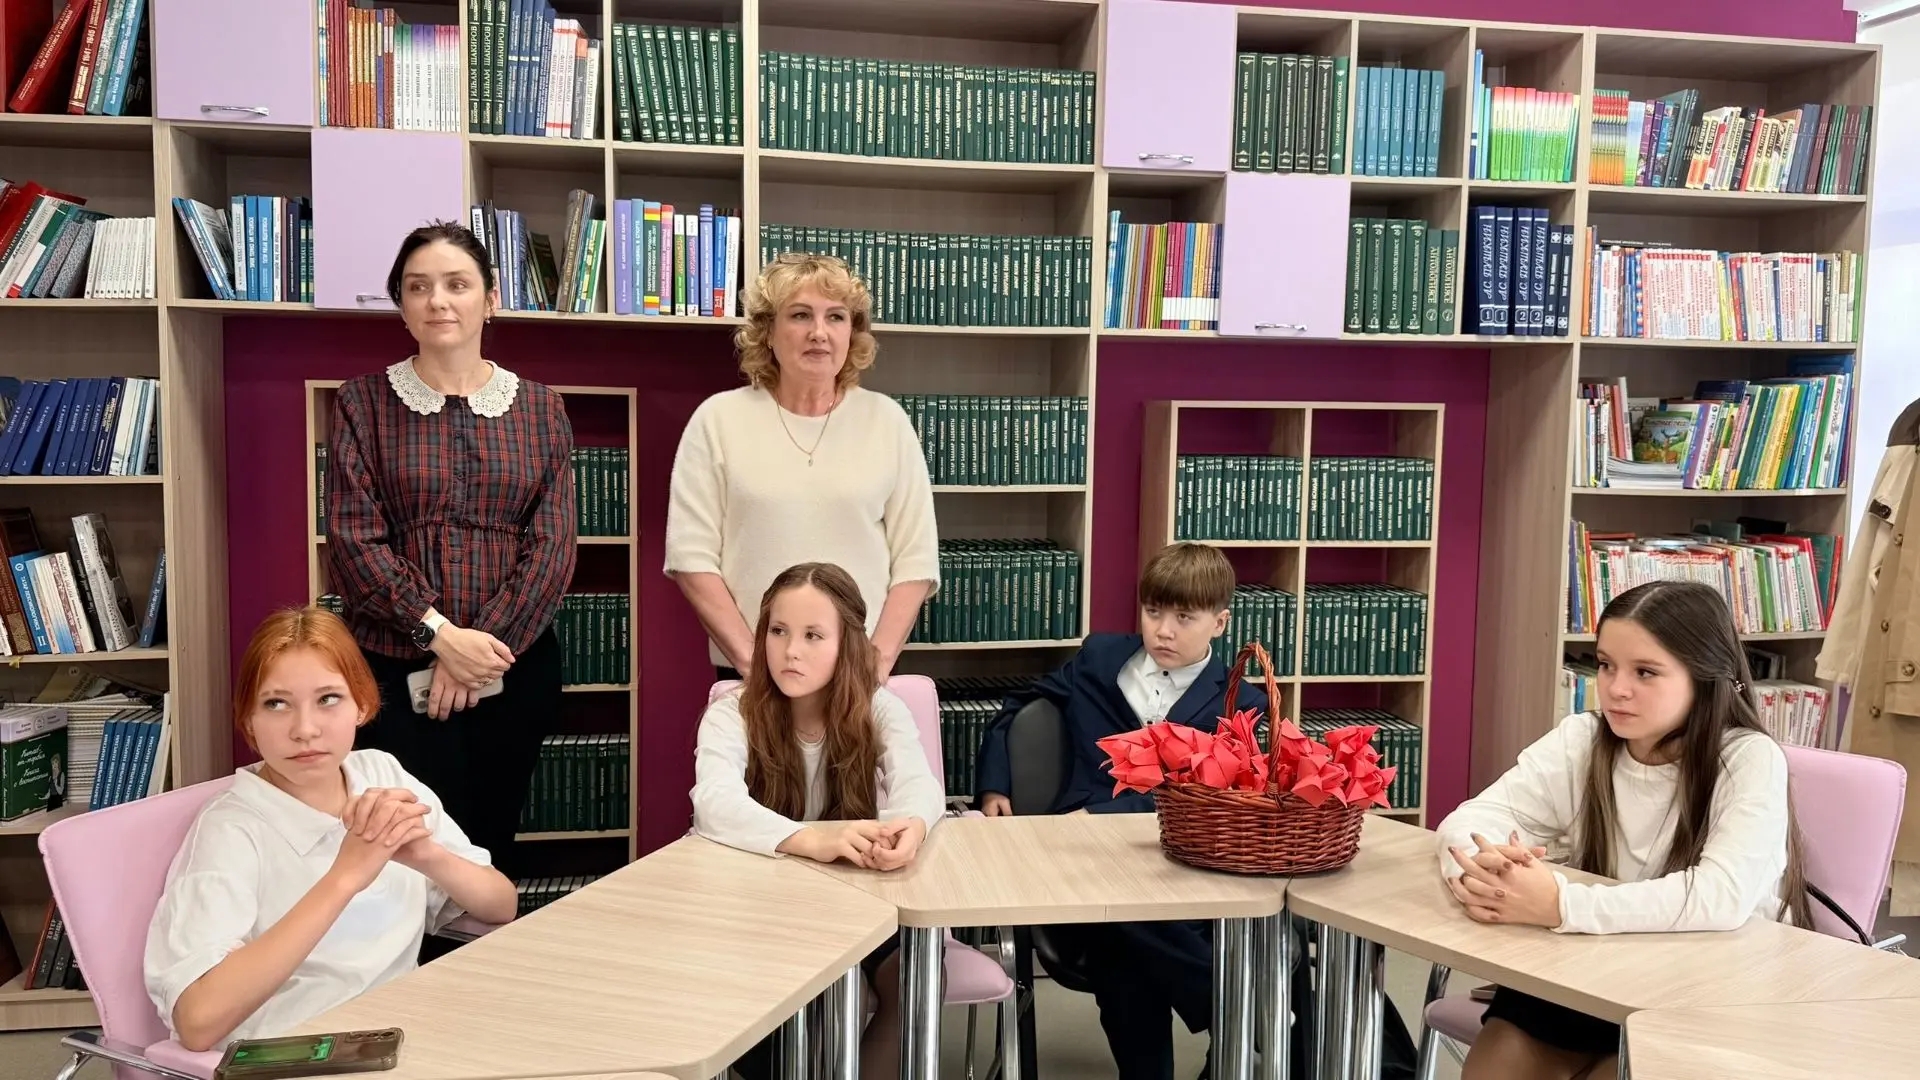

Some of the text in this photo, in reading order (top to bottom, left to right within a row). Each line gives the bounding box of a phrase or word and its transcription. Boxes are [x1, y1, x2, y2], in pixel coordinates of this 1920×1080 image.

[483, 26, 491, 66] ШАКИРОВ
[496, 28, 504, 67] ШАКИРОВ
[1391, 154, 1400, 162] IV
[1482, 224, 1492, 278] ПУШКИН
[1499, 225, 1509, 279] ПУШКИН
[1519, 226, 1529, 279] ПУШКИН
[1534, 226, 1545, 279] ПУШКИН
[1428, 247, 1436, 303] АНТОЛОГИЯСЕ
[1444, 247, 1453, 303] АНТОЛОГИЯСЕ
[1485, 310, 1490, 320] 1
[1500, 312, 1504, 320] 1
[1520, 312, 1526, 320] 2
[1534, 312, 1540, 320] 2
